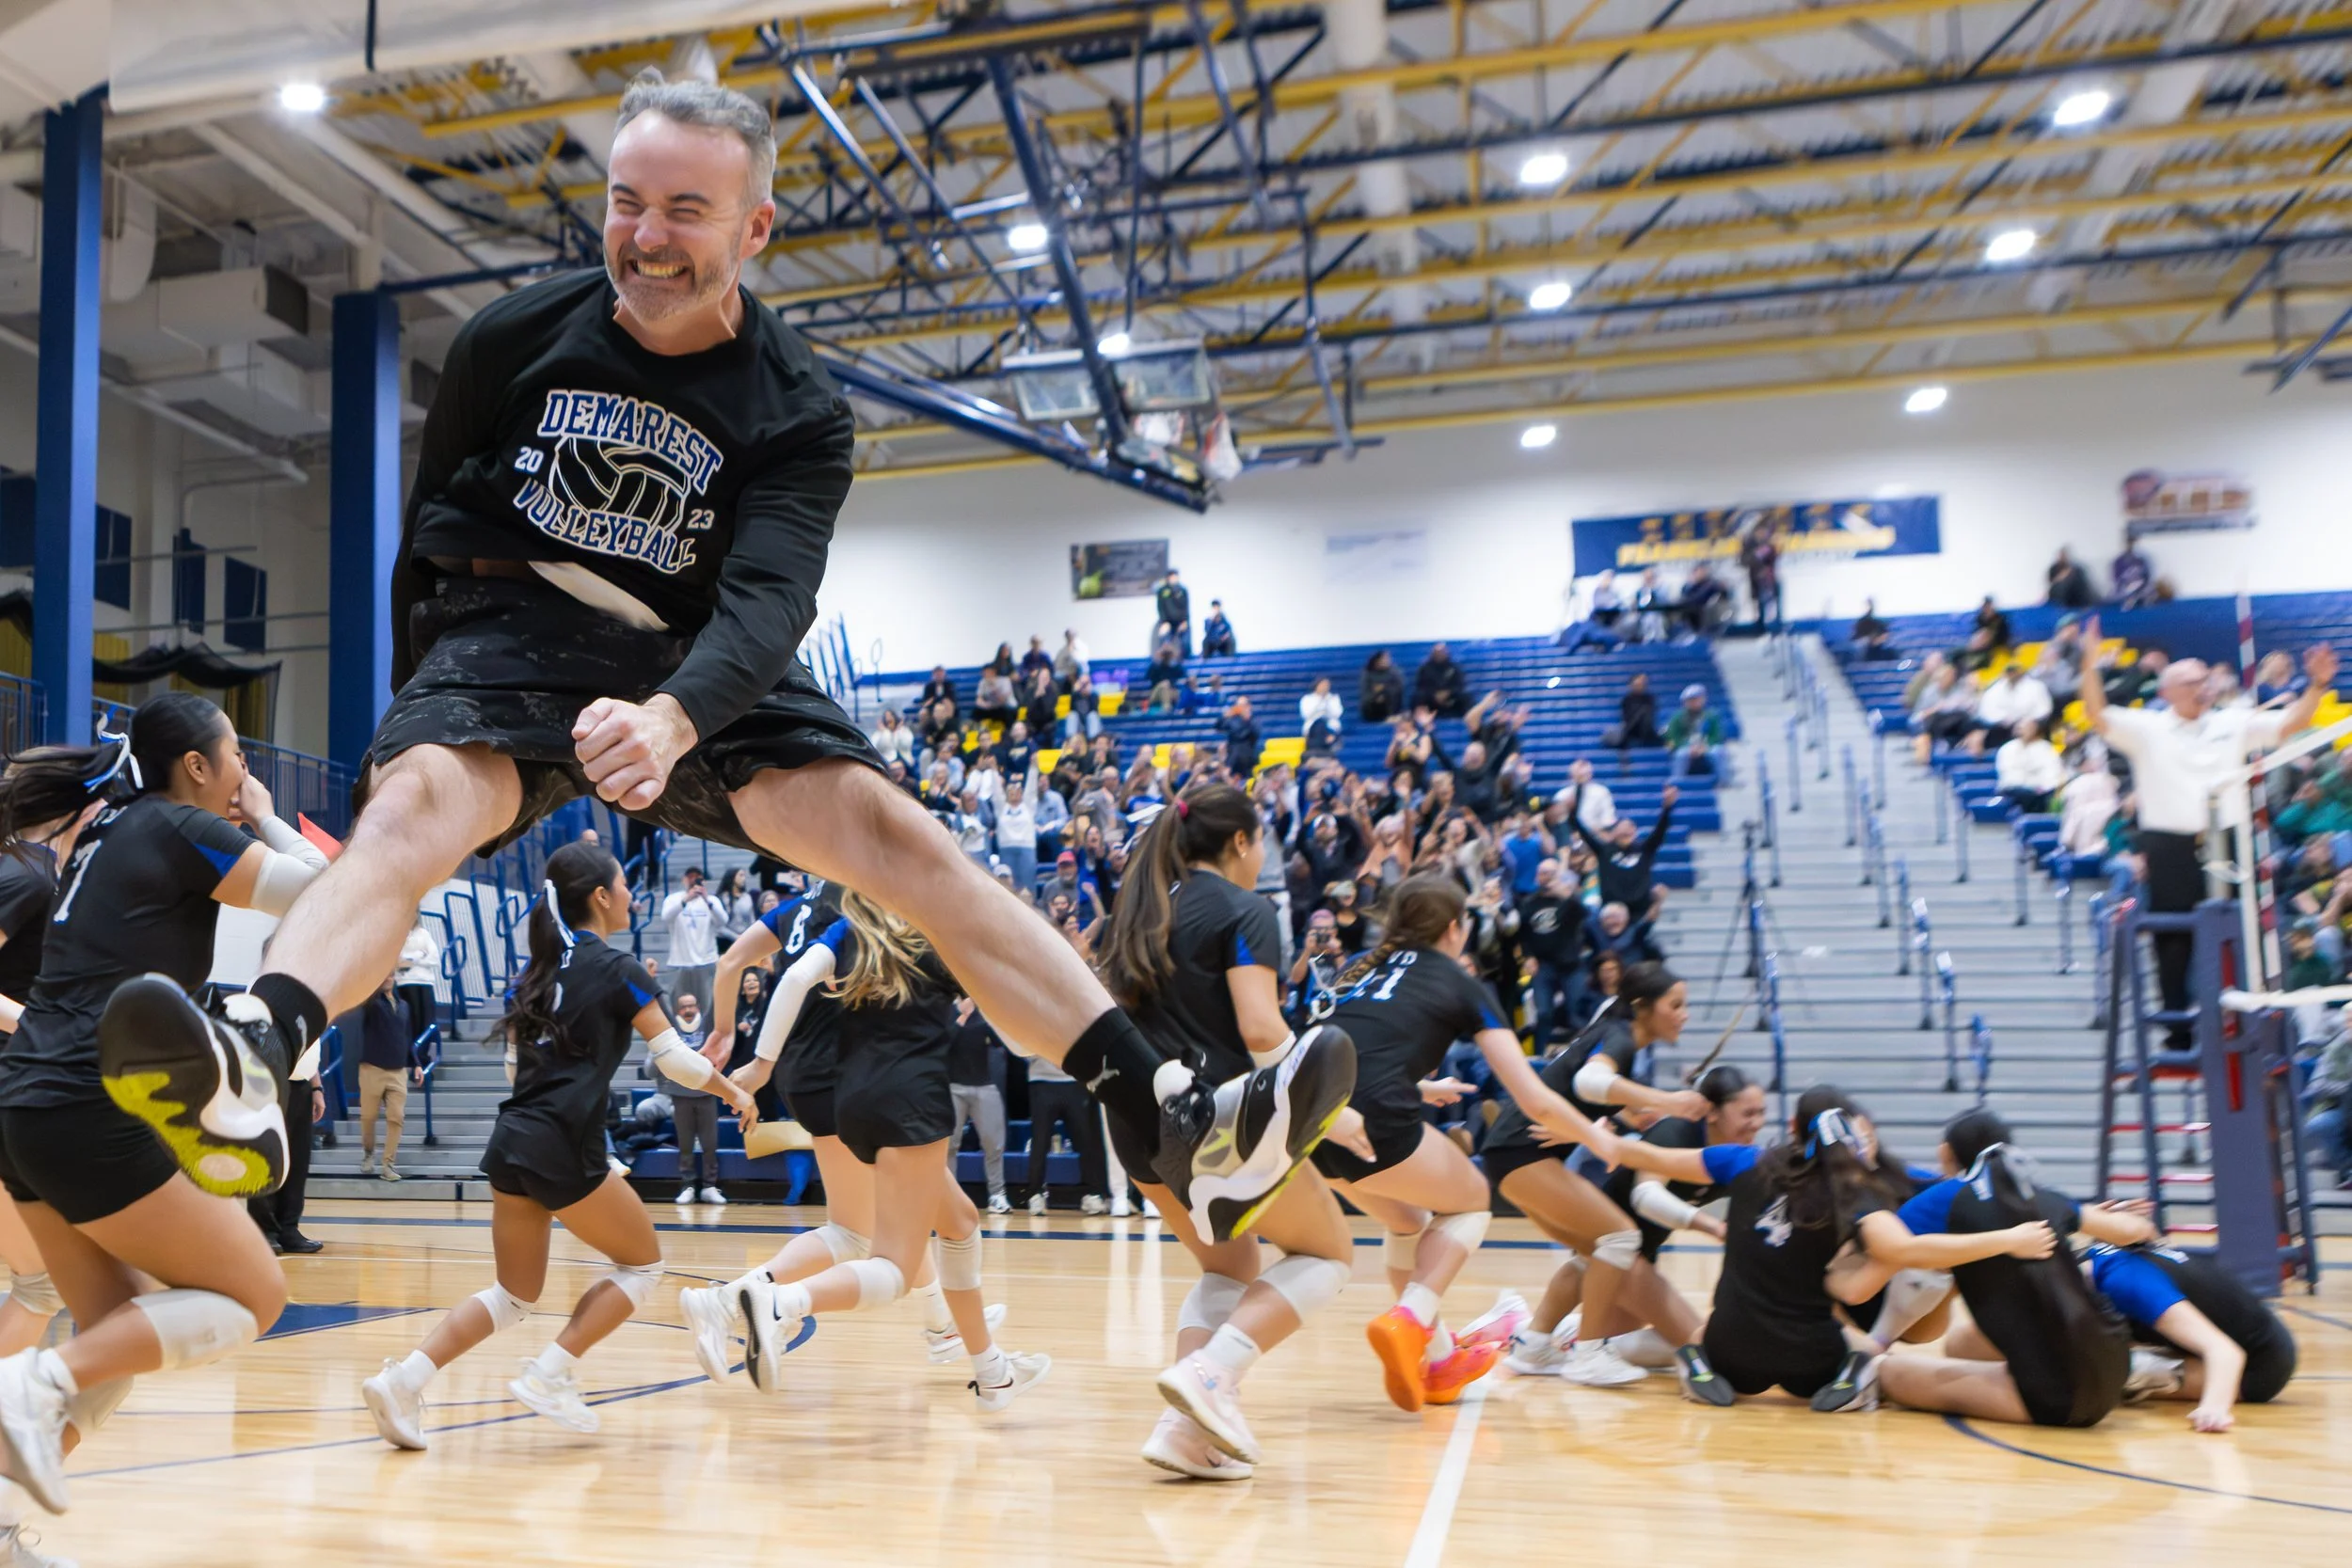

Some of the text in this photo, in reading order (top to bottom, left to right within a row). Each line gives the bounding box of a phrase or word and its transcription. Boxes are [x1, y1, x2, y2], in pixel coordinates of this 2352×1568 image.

[515, 447, 544, 472] 20
[537, 389, 723, 496] DEMAREST
[513, 477, 696, 574] VOLLEYBALL
[686, 509, 715, 530] 23
